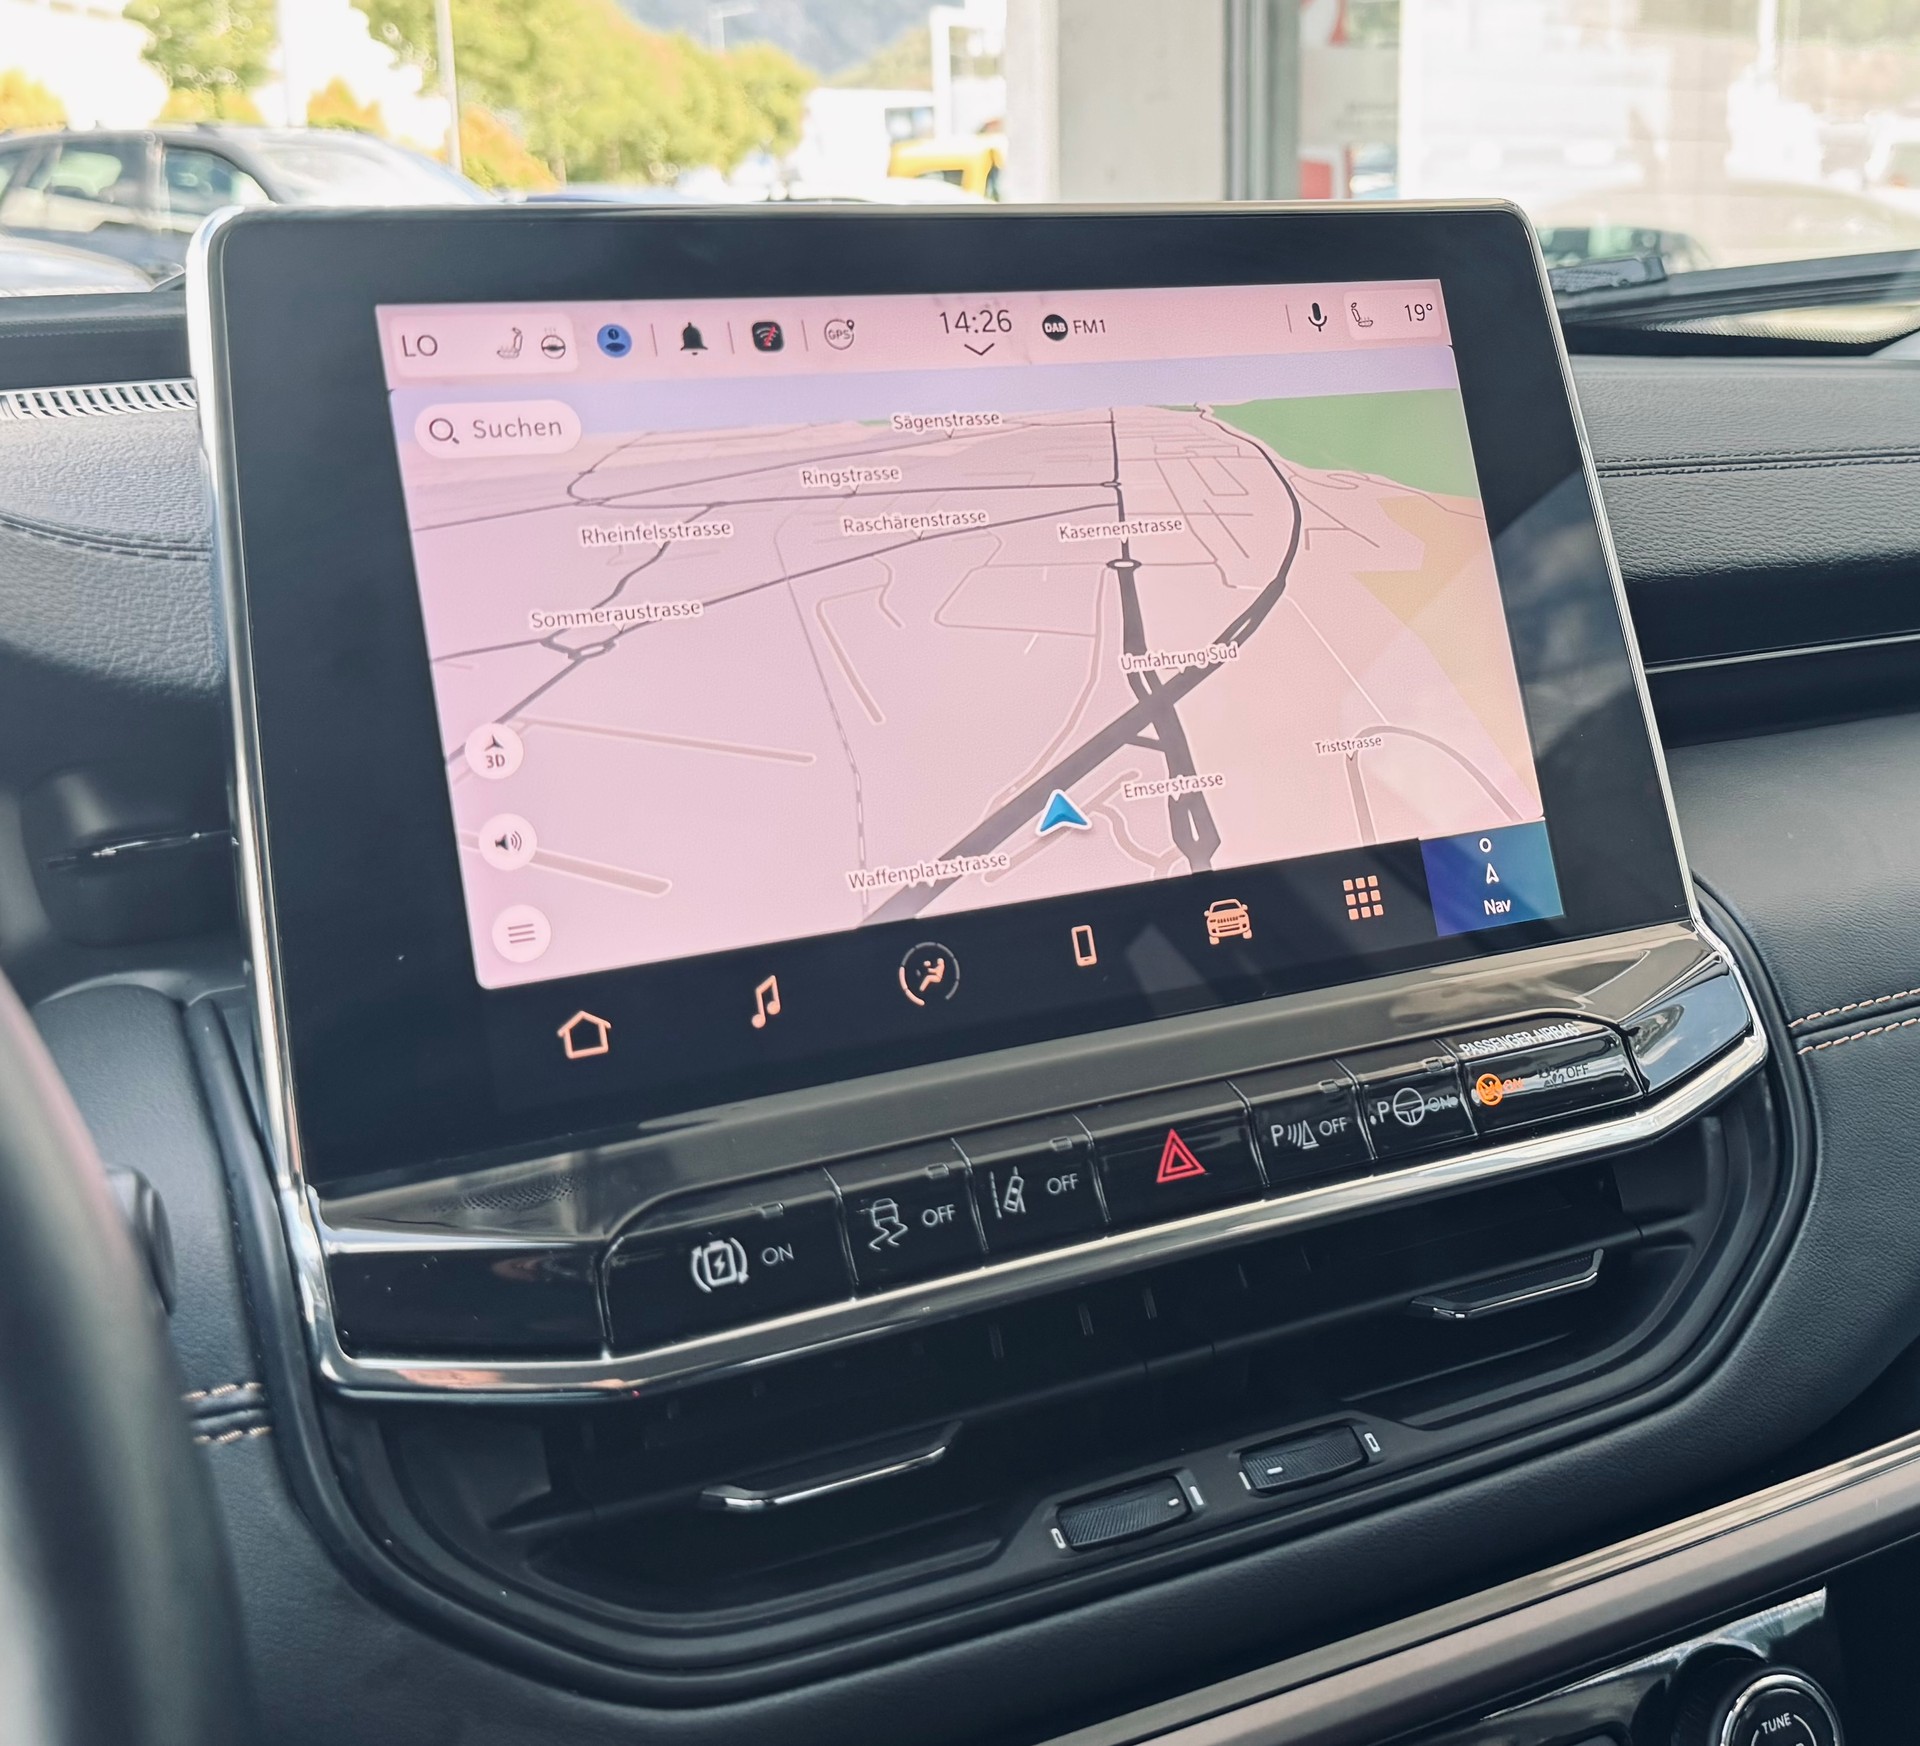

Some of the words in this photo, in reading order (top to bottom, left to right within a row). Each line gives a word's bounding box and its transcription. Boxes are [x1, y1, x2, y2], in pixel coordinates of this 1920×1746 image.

[939, 310, 1012, 335] 14:26
[1404, 303, 1433, 323] 19°
[827, 328, 852, 342] GPS
[1043, 320, 1067, 334] DAB
[1073, 319, 1107, 334] FM1
[402, 334, 439, 358] LO
[472, 418, 563, 440] Suchen
[892, 410, 1001, 431] Sägenstrasse
[802, 466, 901, 487] Ringstrasse
[581, 521, 731, 545] Rheinfelsstrasse
[843, 512, 988, 534] Raschärenstrasse
[1059, 517, 1183, 541] Kasernenstrasse
[531, 599, 703, 630] Sommeraustrasse
[1120, 649, 1207, 672] Umfahrung
[1208, 644, 1238, 662] Süd
[1315, 734, 1382, 754] Triststrasse
[486, 752, 506, 770] 3D
[1123, 772, 1223, 798] Emserstrasse
[848, 851, 1008, 889] Waffenplatzstrasse
[1484, 897, 1511, 916] Nav
[1459, 1031, 1534, 1057] PASSENGER
[1535, 1022, 1579, 1043] AIRBAG
[1565, 1063, 1589, 1079] OFF
[1319, 1117, 1347, 1137] OFF
[1047, 1173, 1078, 1195] OFF
[922, 1204, 955, 1228] OFF
[762, 1242, 794, 1267] ON
[1762, 1712, 1792, 1735] TUNE
